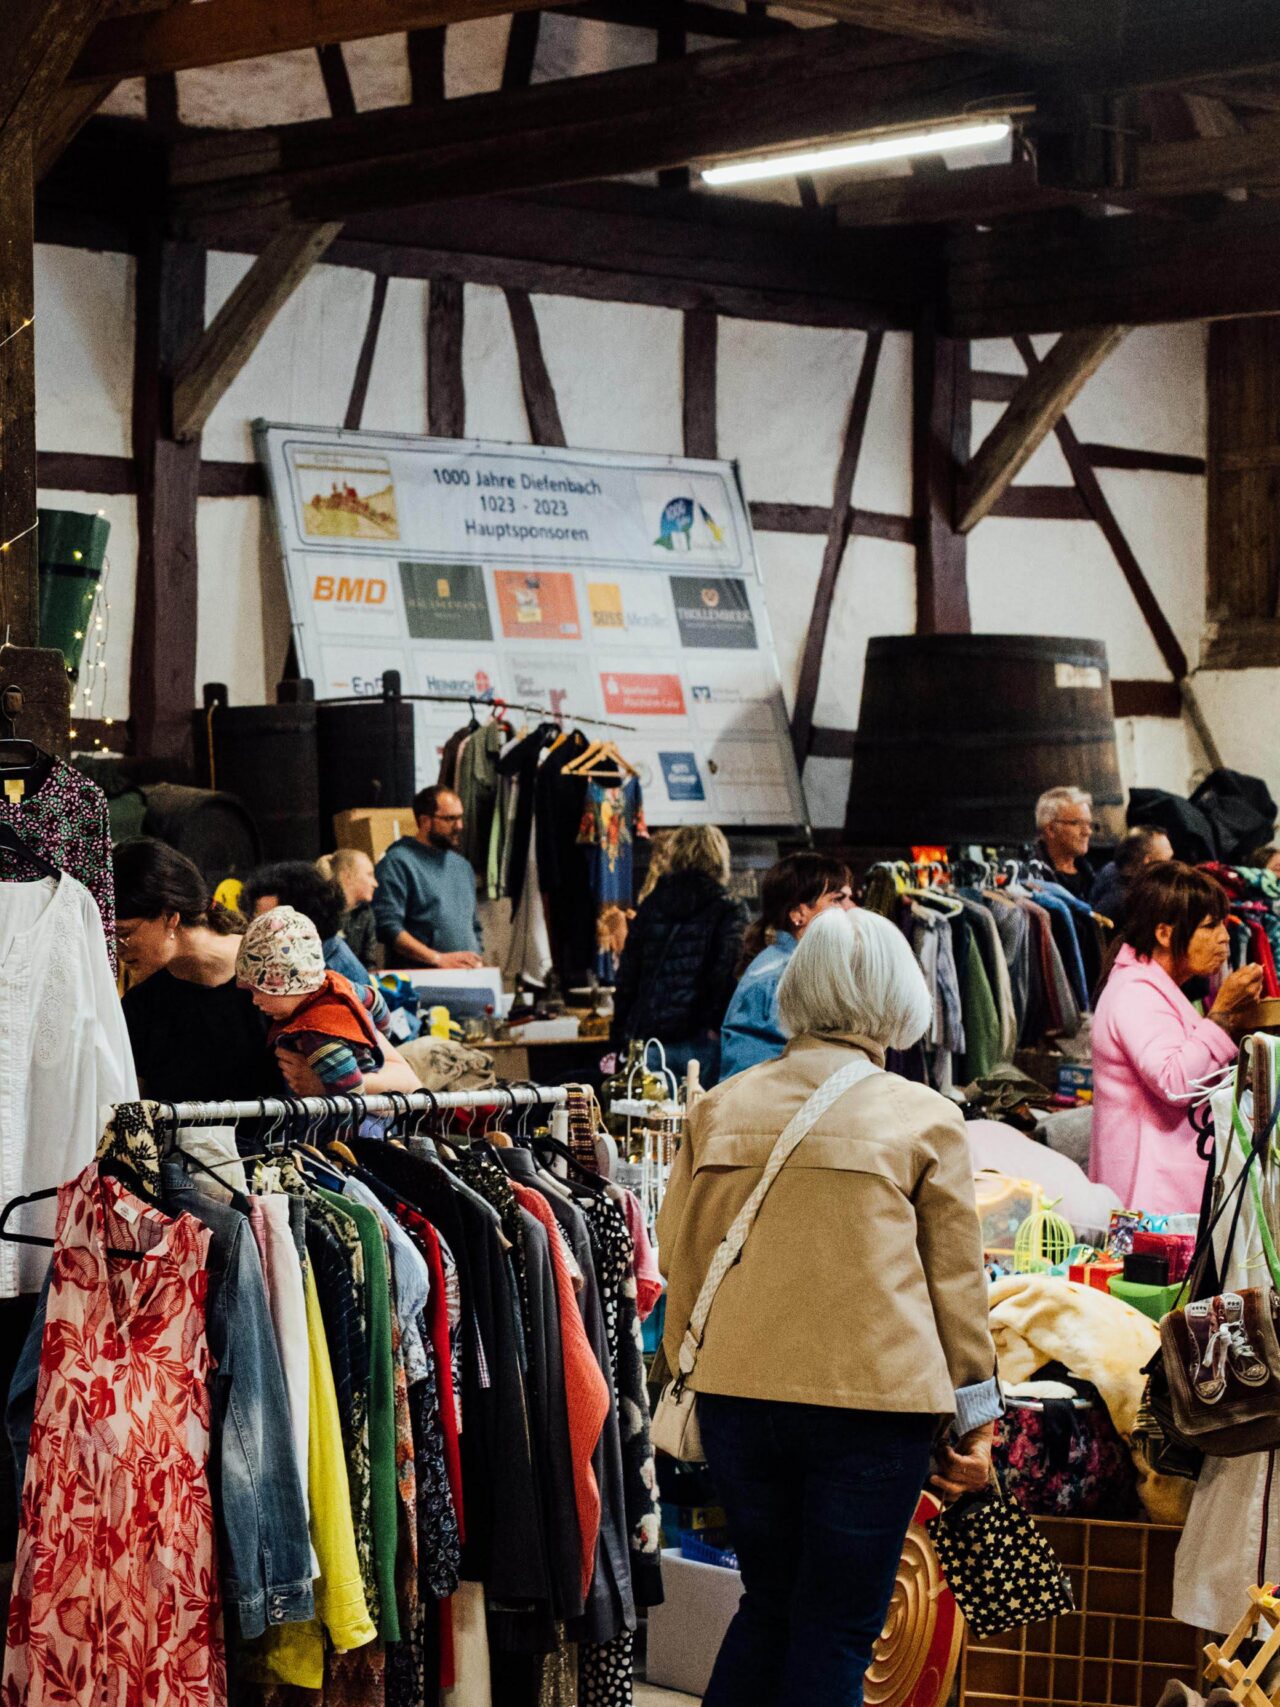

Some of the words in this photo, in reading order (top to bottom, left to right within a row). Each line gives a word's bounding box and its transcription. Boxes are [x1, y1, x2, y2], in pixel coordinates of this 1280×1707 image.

[433, 468, 471, 486] 1000
[476, 470, 516, 489] Jahre
[520, 474, 602, 495] Diefenbach
[480, 495, 516, 514] 1023
[534, 498, 569, 517] 2023
[464, 519, 590, 542] Hauptsponsoren
[313, 576, 389, 605] BMD
[351, 676, 384, 696] En
